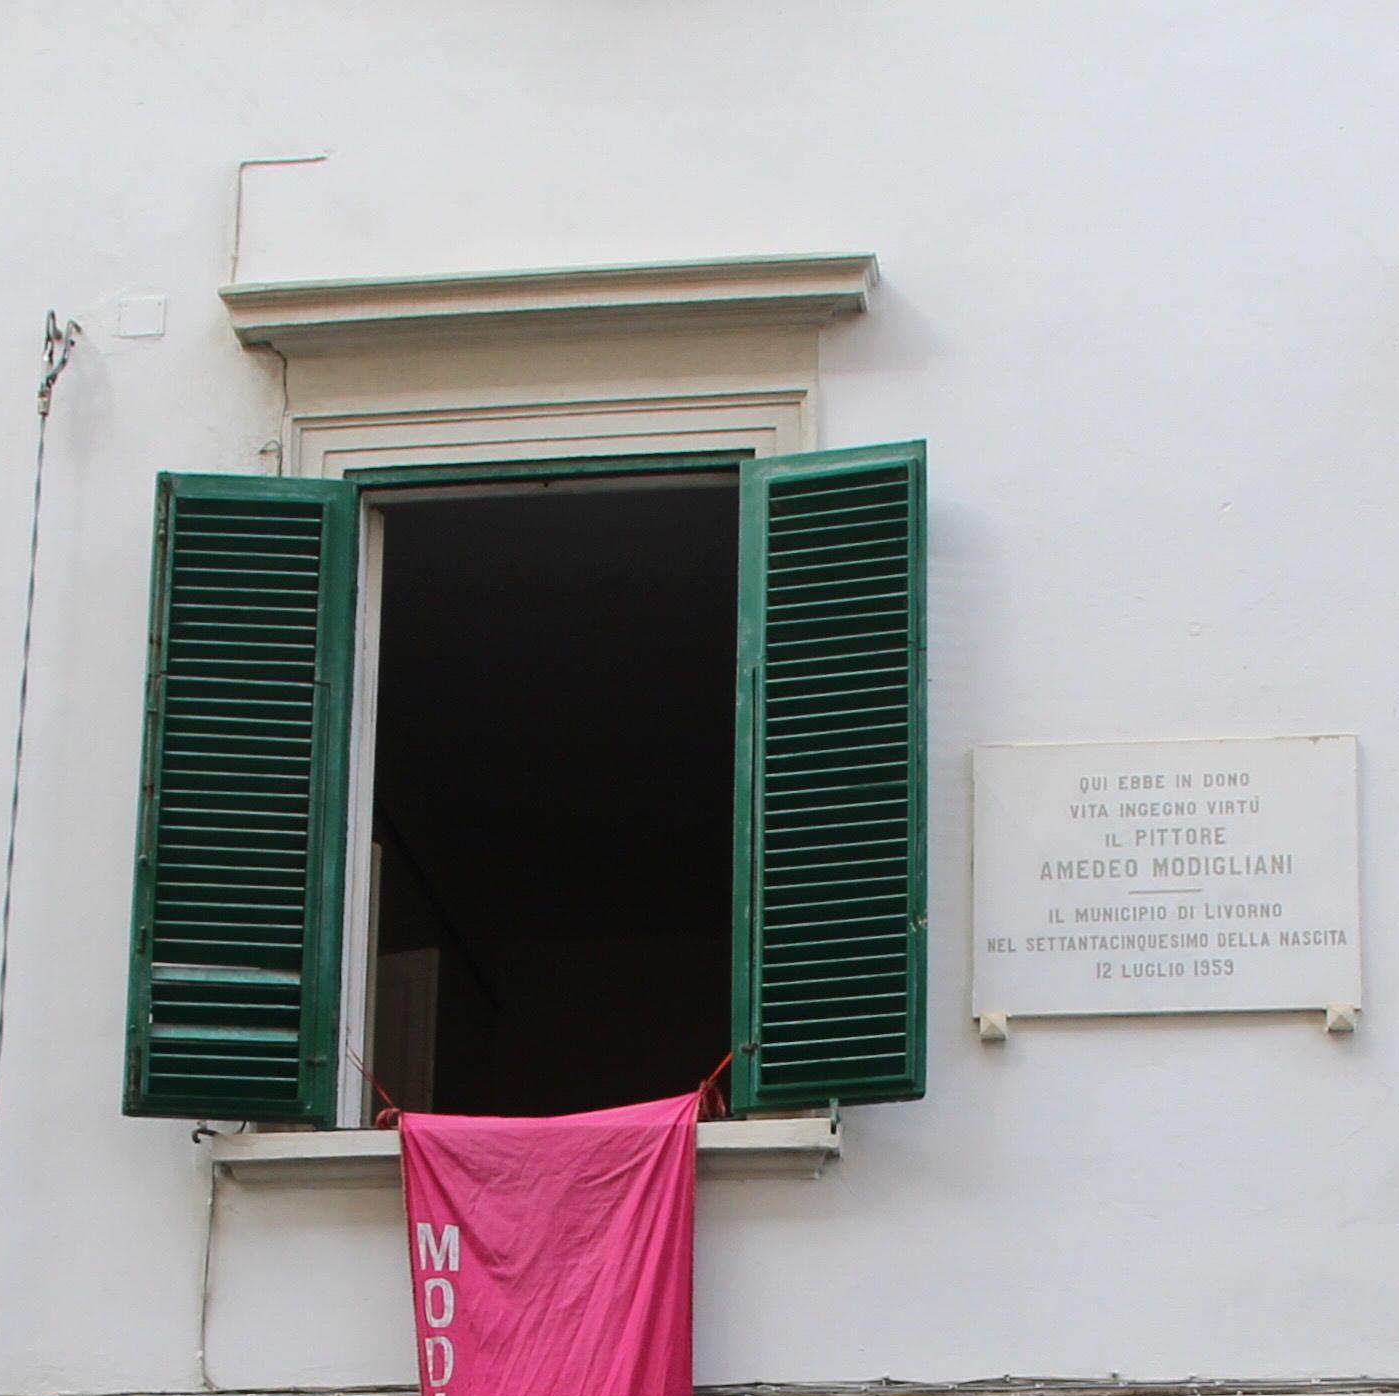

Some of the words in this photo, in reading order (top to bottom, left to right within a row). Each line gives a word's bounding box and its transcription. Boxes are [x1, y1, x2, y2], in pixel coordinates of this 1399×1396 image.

[1079, 776, 1108, 794] QUI
[1118, 775, 1166, 790] EBBE
[1176, 774, 1192, 789] IN
[1203, 772, 1250, 788] DONO
[1070, 803, 1109, 819] VITA
[1120, 802, 1197, 817] INGEGNO
[1106, 833, 1122, 847] IL
[1135, 827, 1227, 847] PITTORE
[1040, 859, 1138, 880] AMEDEO
[1153, 855, 1293, 878] MODIGLIANI
[1048, 908, 1065, 924] IL
[1075, 906, 1167, 923] MUNICIPIO
[1178, 905, 1194, 921] DI
[1204, 903, 1283, 919] LIVORNO
[987, 938, 1016, 953] NEL
[1026, 934, 1209, 952] SETTANTACINQUESIMO
[1217, 932, 1270, 947] DELLA
[1280, 930, 1347, 946] NASCITA
[1096, 963, 1112, 979] 12
[1121, 962, 1184, 978] LUGLIO
[1194, 960, 1234, 976] 1959
